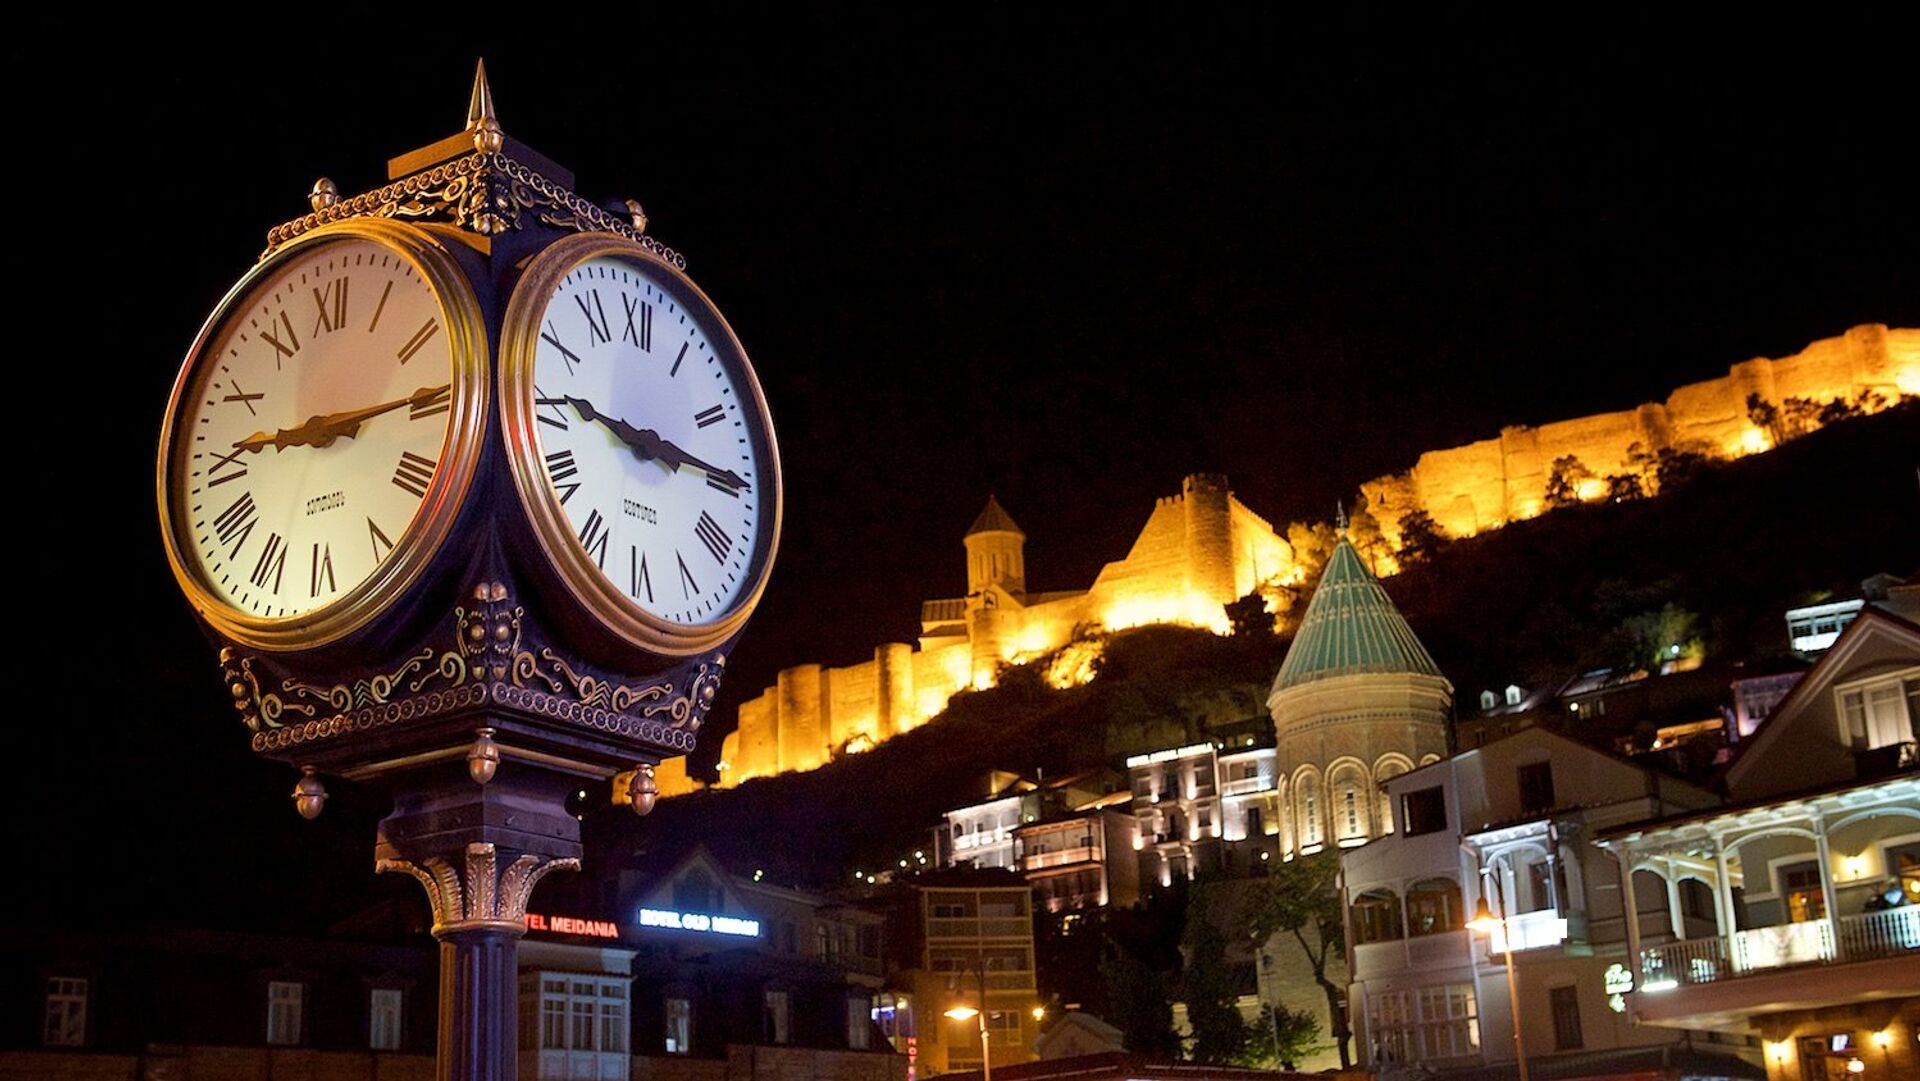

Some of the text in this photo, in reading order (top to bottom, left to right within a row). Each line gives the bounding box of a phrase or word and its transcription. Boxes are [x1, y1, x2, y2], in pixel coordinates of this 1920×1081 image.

[313, 276, 349, 338] XII
[574, 288, 612, 347] XI
[622, 291, 652, 353] XII
[260, 310, 300, 371] XI
[541, 319, 581, 376] X
[223, 380, 265, 416] X
[551, 915, 618, 938] MEIDANIA
